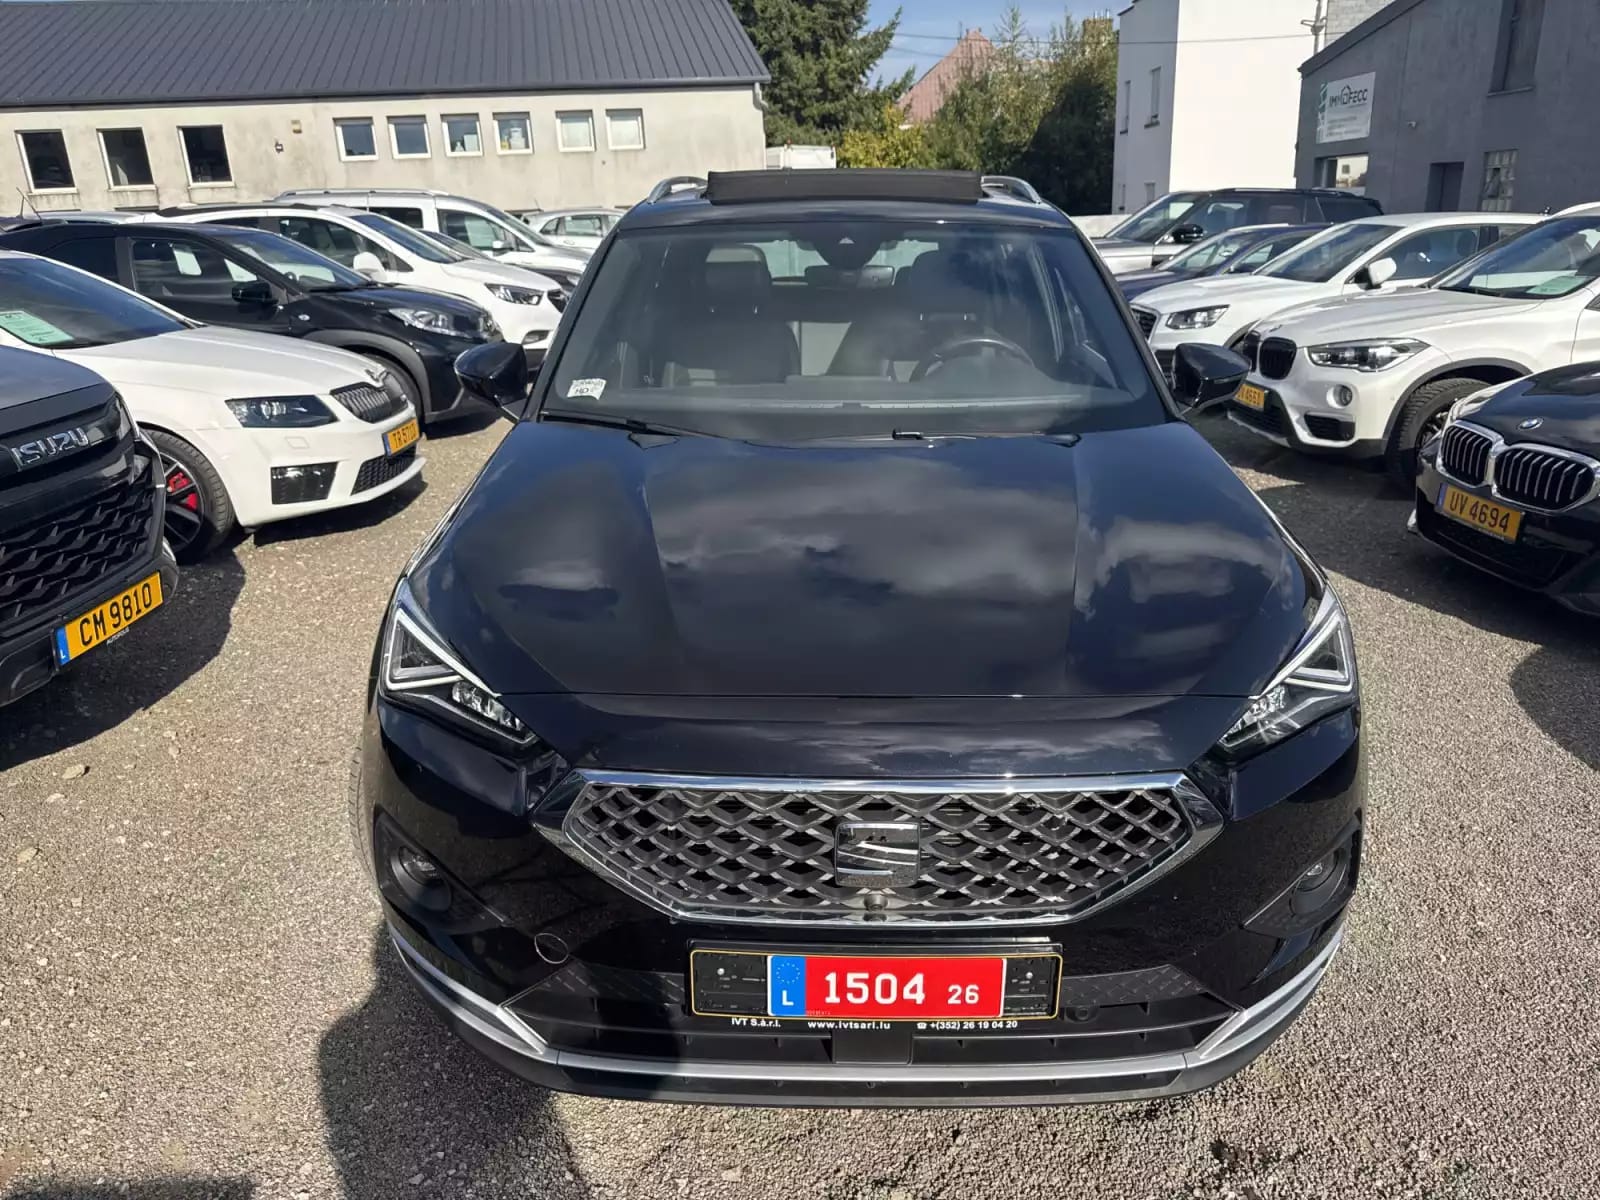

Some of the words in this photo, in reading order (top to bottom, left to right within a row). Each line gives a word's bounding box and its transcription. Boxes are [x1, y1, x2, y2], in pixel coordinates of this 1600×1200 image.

[11, 427, 88, 472] ISUZU
[392, 430, 402, 449] TR
[1449, 491, 1468, 515] UV
[1469, 500, 1510, 533] 4694
[60, 649, 66, 660] L
[79, 609, 107, 646] CM
[109, 583, 152, 629] 9810
[781, 990, 794, 1006] L
[824, 972, 926, 1005] 1504
[947, 984, 980, 1005] 26
[731, 1017, 748, 1026] IVT
[807, 1020, 891, 1030] www.ivtsarl.lu
[929, 1020, 961, 1031] +(352)
[962, 1021, 975, 1030] 26
[978, 1020, 989, 1029] 19
[991, 1020, 1003, 1029] 04
[1006, 1020, 1018, 1028] 20
